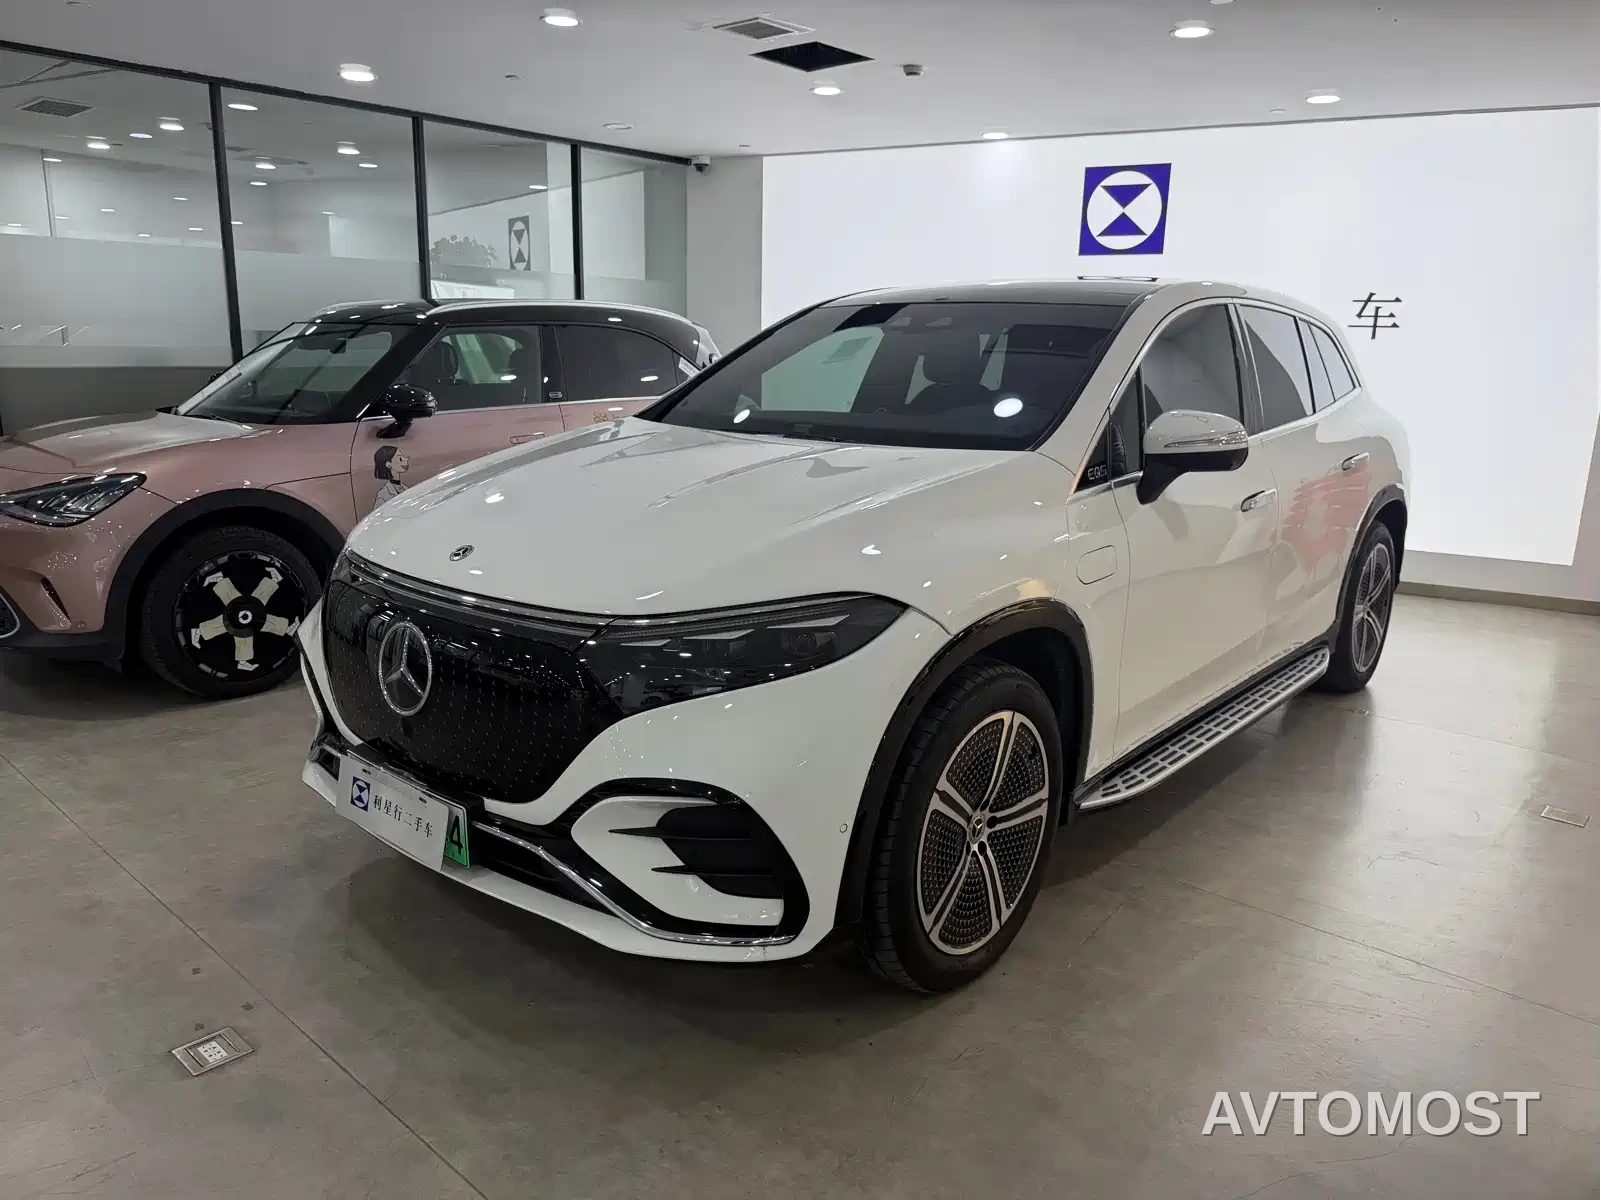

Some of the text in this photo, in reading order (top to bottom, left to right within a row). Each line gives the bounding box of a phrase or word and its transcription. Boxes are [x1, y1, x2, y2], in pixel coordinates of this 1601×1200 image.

[1347, 292, 1402, 340] 车
[1087, 464, 1108, 481] EQS
[373, 795, 433, 839] 利星行二手车
[450, 815, 464, 856] 4
